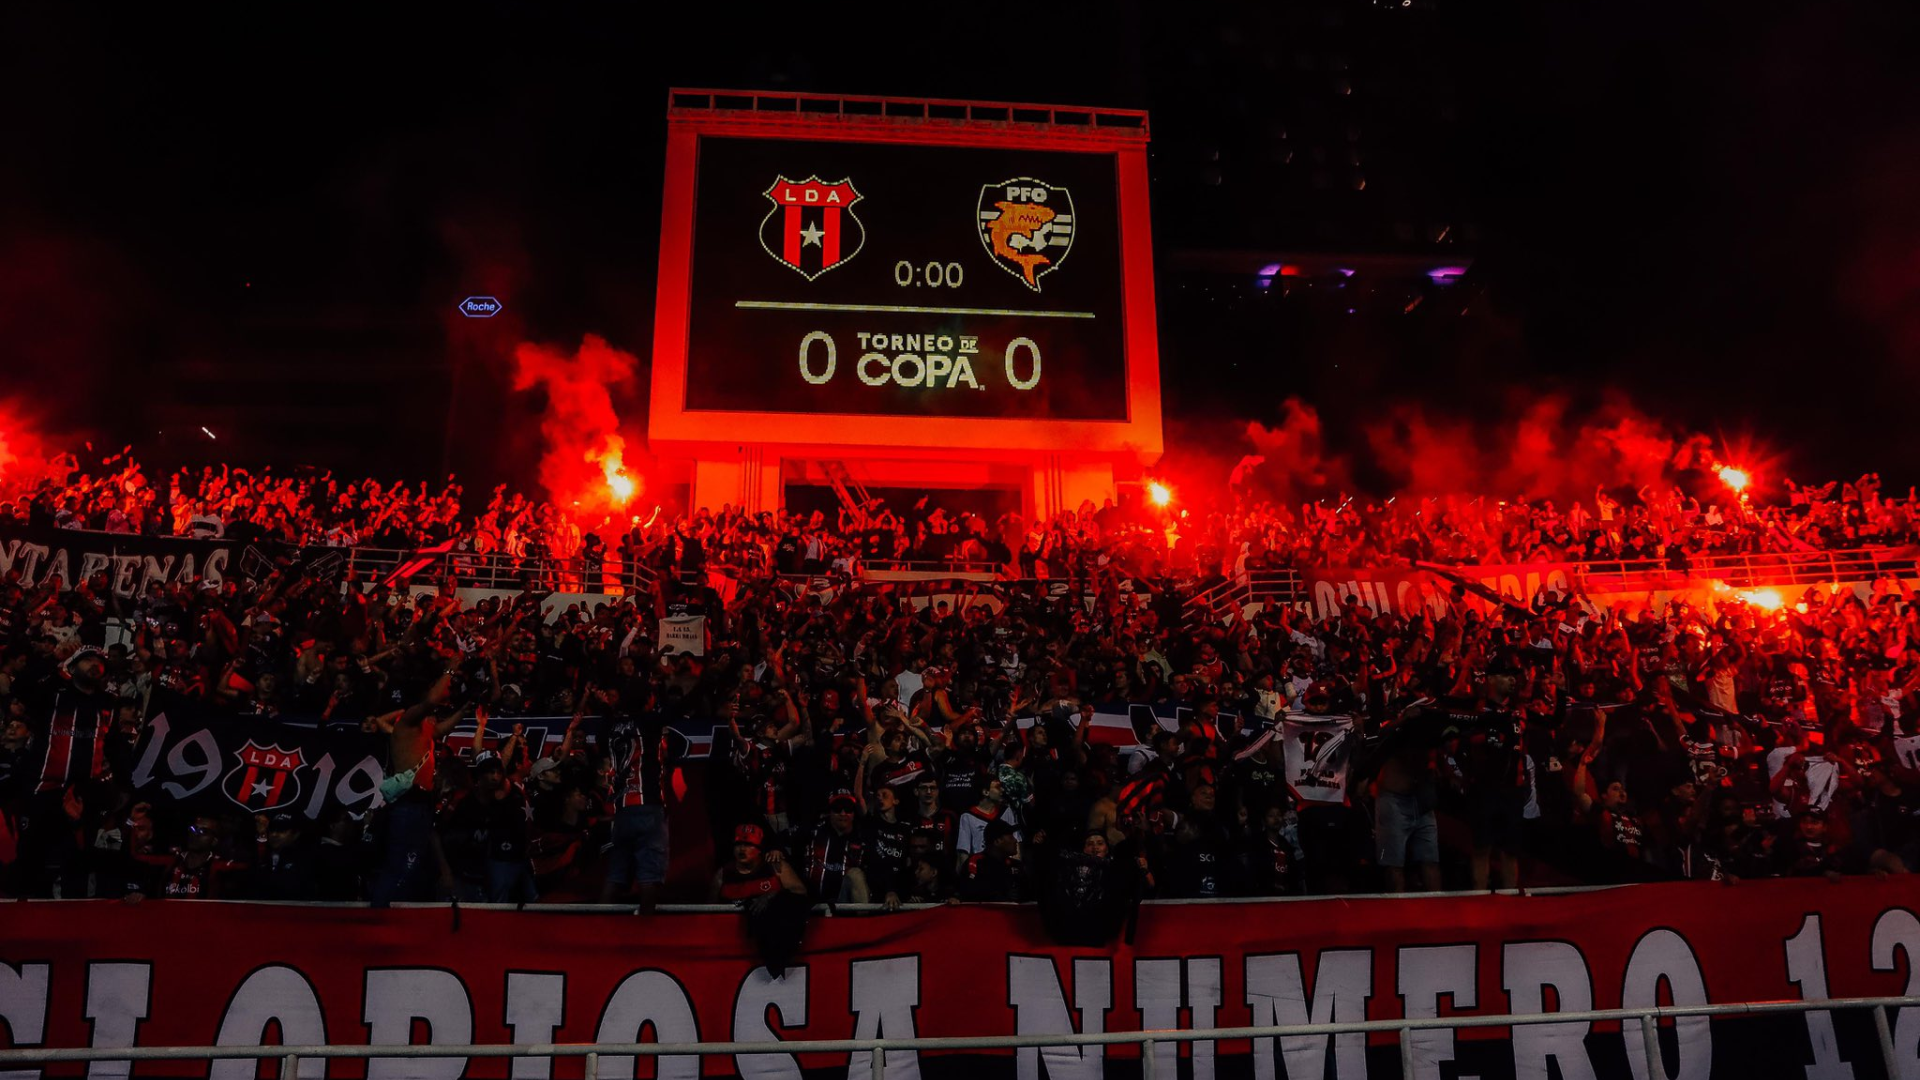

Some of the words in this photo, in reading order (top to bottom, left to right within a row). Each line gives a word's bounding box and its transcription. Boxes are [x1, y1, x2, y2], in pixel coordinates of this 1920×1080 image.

[785, 188, 841, 204] LDA
[894, 261, 964, 288] 0:00
[467, 301, 495, 311] Roche
[799, 331, 837, 385] 0
[857, 332, 954, 351] TORNEO
[960, 338, 978, 351] DE
[857, 352, 979, 389] COPA
[1005, 337, 1042, 390] 0
[131, 711, 223, 801] 19
[250, 751, 293, 768] LDA
[1784, 907, 1920, 1080] 12
